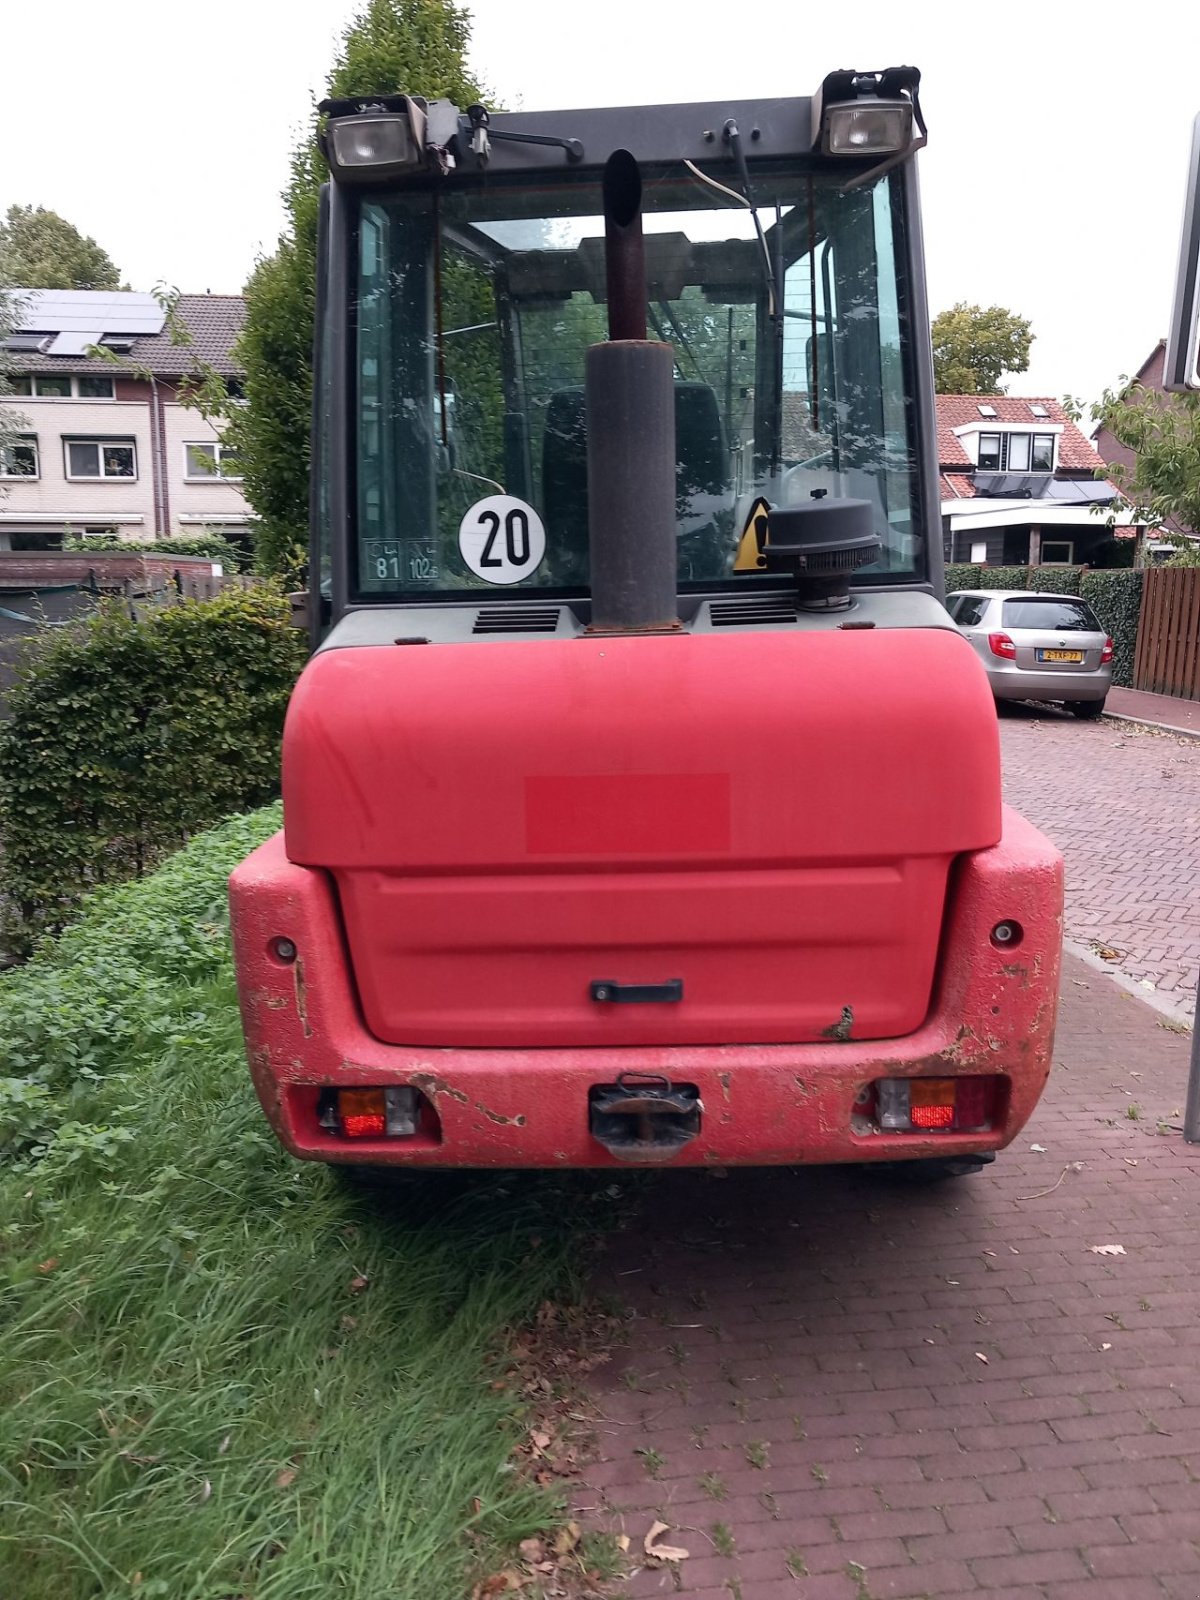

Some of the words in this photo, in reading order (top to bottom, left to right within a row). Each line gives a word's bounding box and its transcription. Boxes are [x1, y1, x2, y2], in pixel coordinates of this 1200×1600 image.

[477, 508, 530, 568] 20
[377, 557, 399, 578] 81
[409, 558, 430, 578] 102
